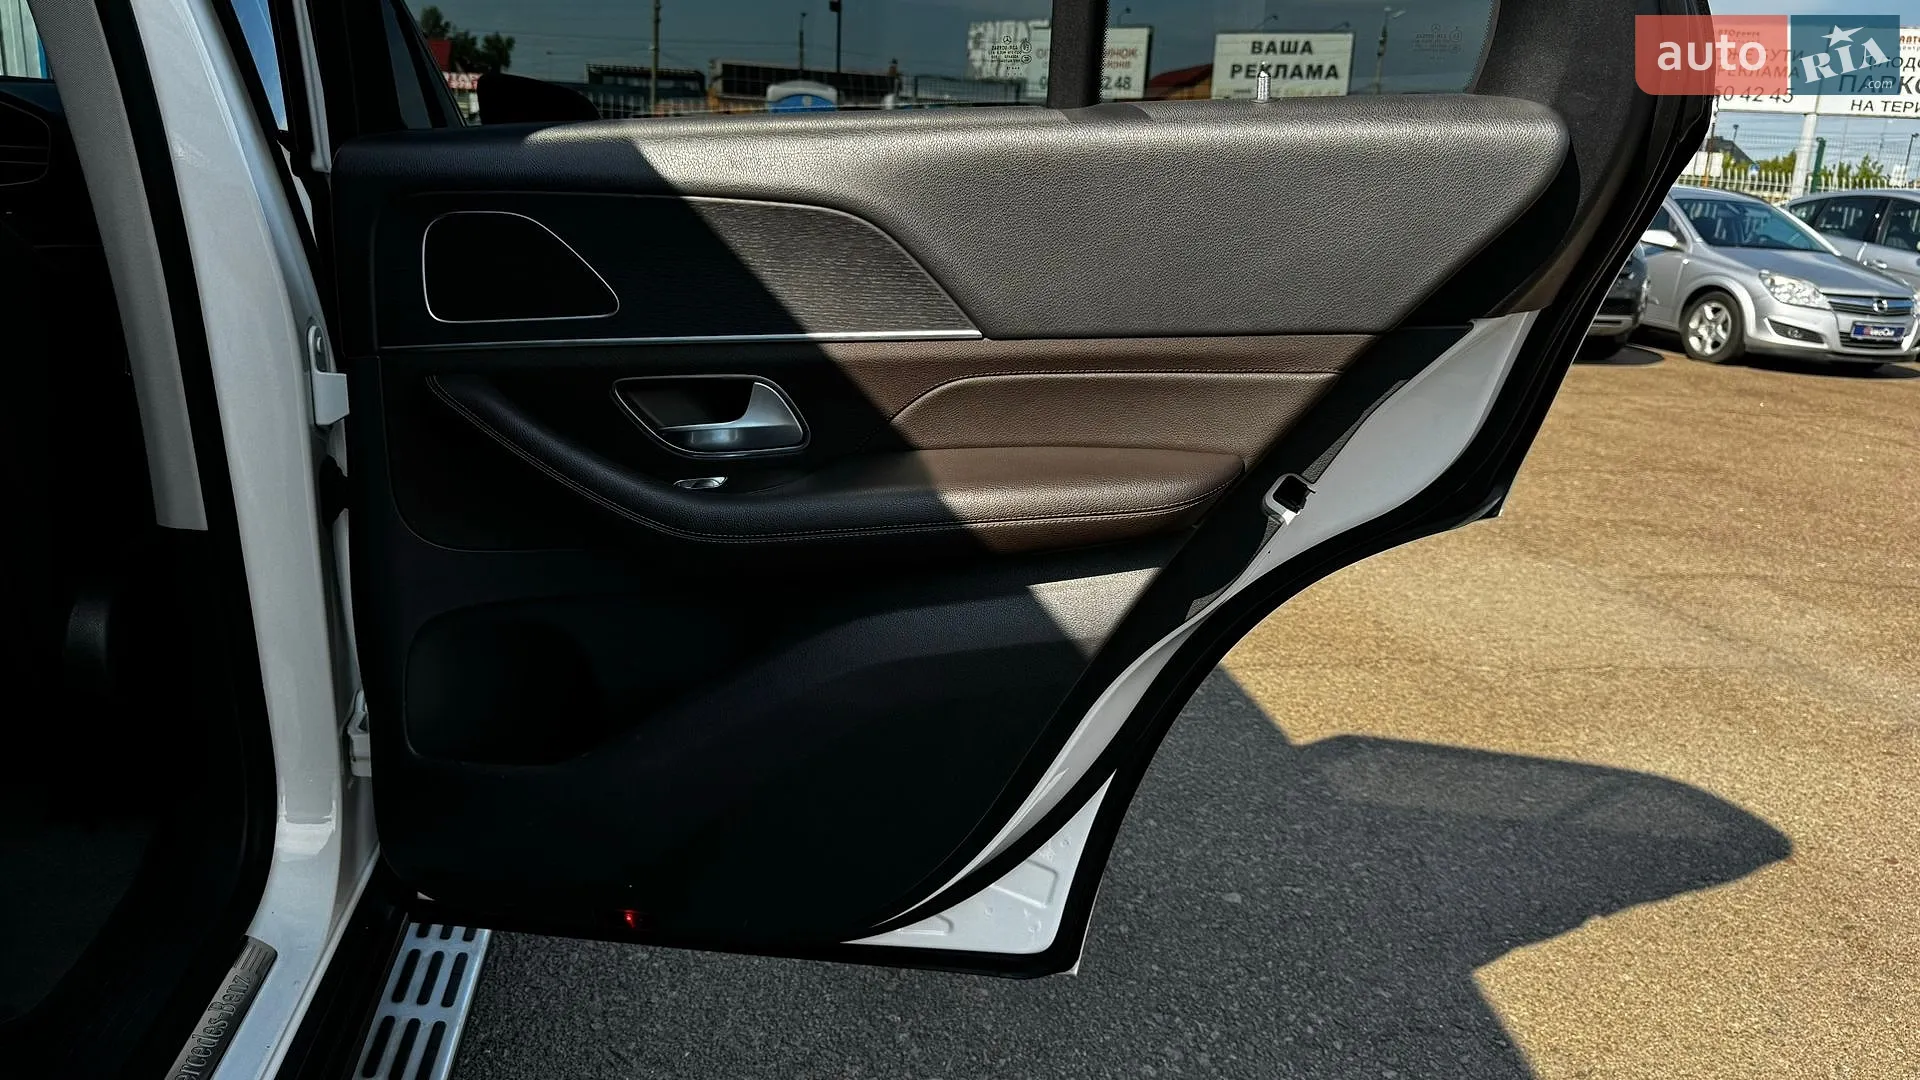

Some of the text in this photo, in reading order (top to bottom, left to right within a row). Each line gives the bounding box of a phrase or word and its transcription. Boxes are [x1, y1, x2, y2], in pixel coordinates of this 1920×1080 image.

[1250, 40, 1313, 55] ВАША
[1230, 63, 1339, 79] РЕКЛАМА
[1740, 86, 1764, 103] 42
[1769, 87, 1794, 103] 45
[1850, 99, 1874, 112] НА
[174, 974, 251, 1080] ercedes-Benz
